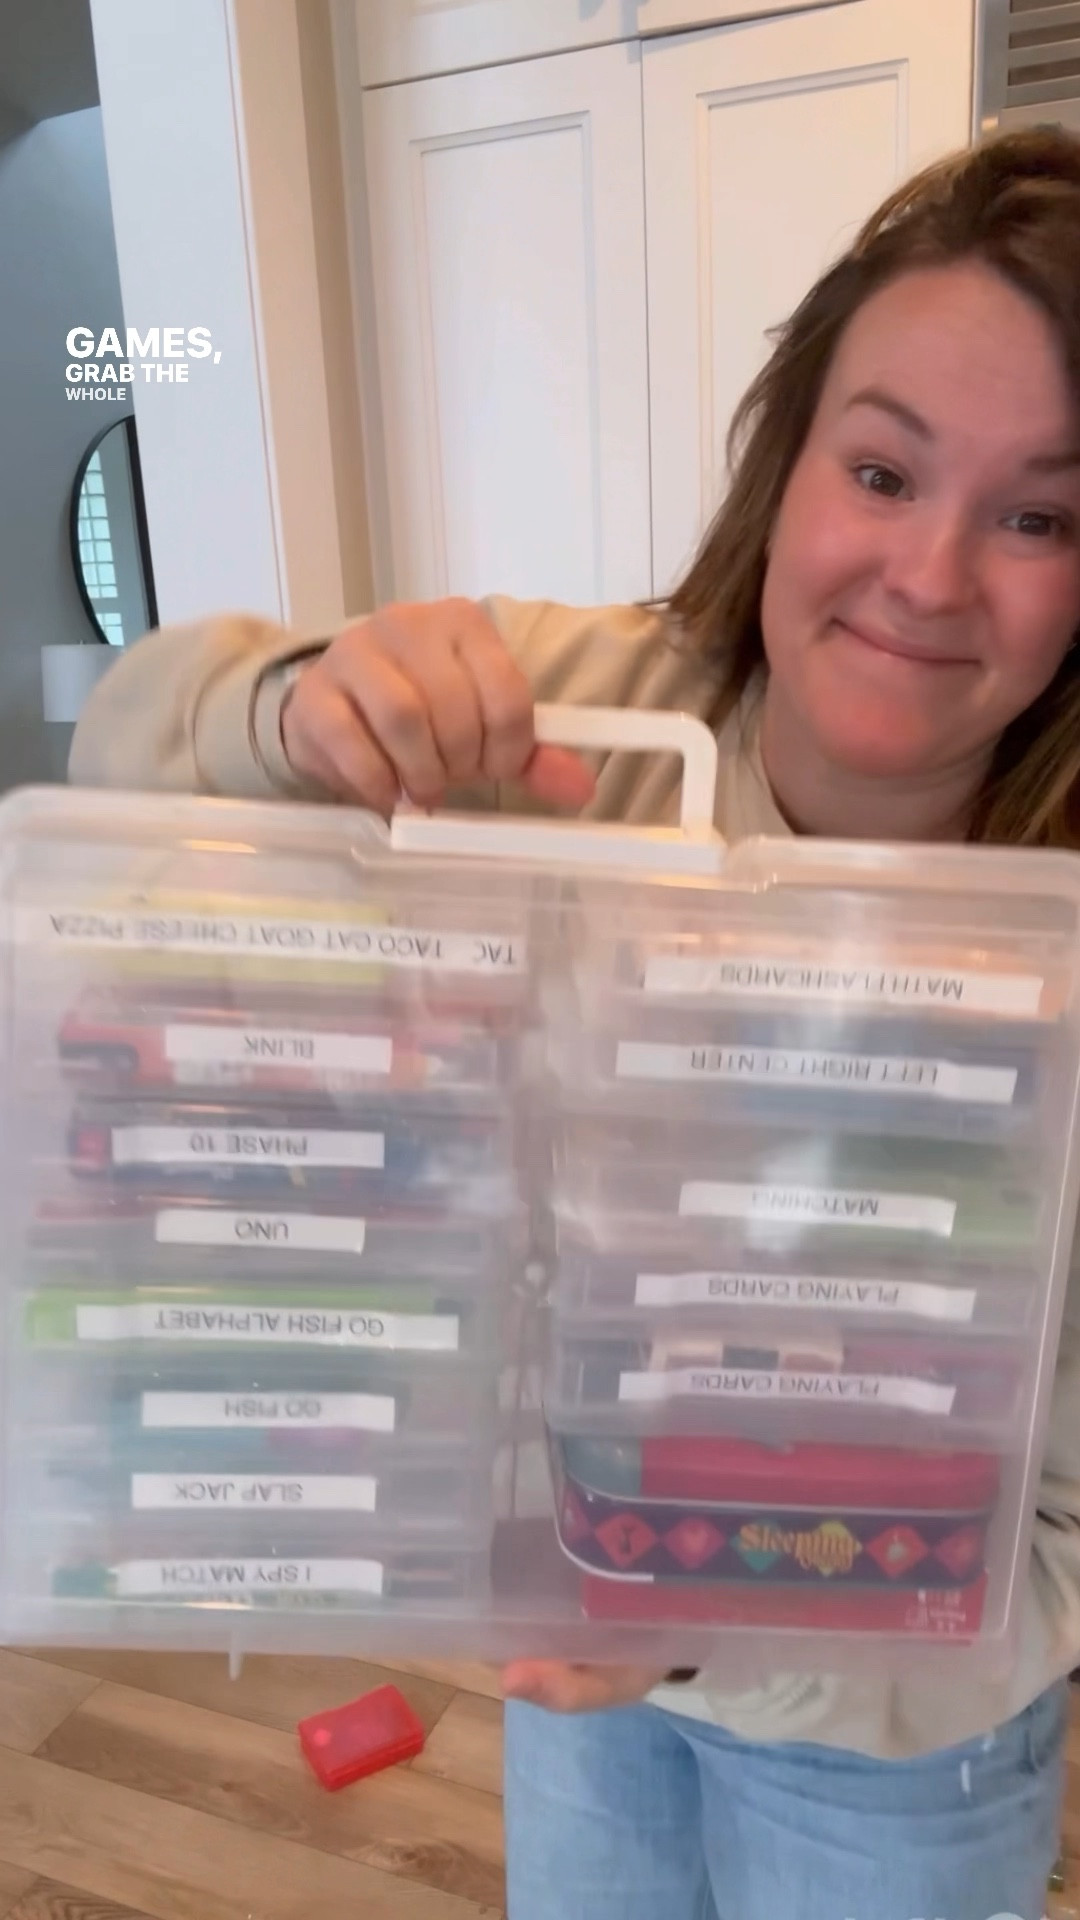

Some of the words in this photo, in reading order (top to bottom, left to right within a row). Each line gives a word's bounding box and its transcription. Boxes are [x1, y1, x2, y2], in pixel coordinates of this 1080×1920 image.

[49, 915, 125, 937] PIZZA
[132, 918, 237, 943] CHEESE
[246, 924, 315, 949] GOAT
[322, 930, 371, 953] CAT
[376, 935, 444, 960] TACO
[887, 974, 965, 1001] MATH
[241, 1036, 315, 1059] BLINK
[690, 1050, 790, 1077] CENTER
[798, 1057, 872, 1082] RIGHT
[880, 1063, 938, 1086] LEFT
[189, 1134, 218, 1154] 10
[226, 1135, 308, 1156] PHASE
[751, 1191, 880, 1218] MATCHING
[235, 1219, 290, 1241] UNO
[707, 1278, 789, 1300] CARDS
[796, 1282, 900, 1303] PLAYING
[154, 1310, 281, 1334] ALPHABET
[286, 1315, 342, 1337] FISH
[348, 1317, 386, 1339] GO
[690, 1373, 773, 1393] CARDS
[778, 1376, 881, 1396] PLAYING
[223, 1398, 279, 1418] FISH
[285, 1399, 322, 1419] GO
[170, 1481, 235, 1501] JACK
[240, 1482, 304, 1501] SLAP
[737, 1524, 859, 1556] Sleeping
[160, 1564, 246, 1584] MATCH
[253, 1564, 300, 1583] SPY
[305, 1566, 312, 1582] I
